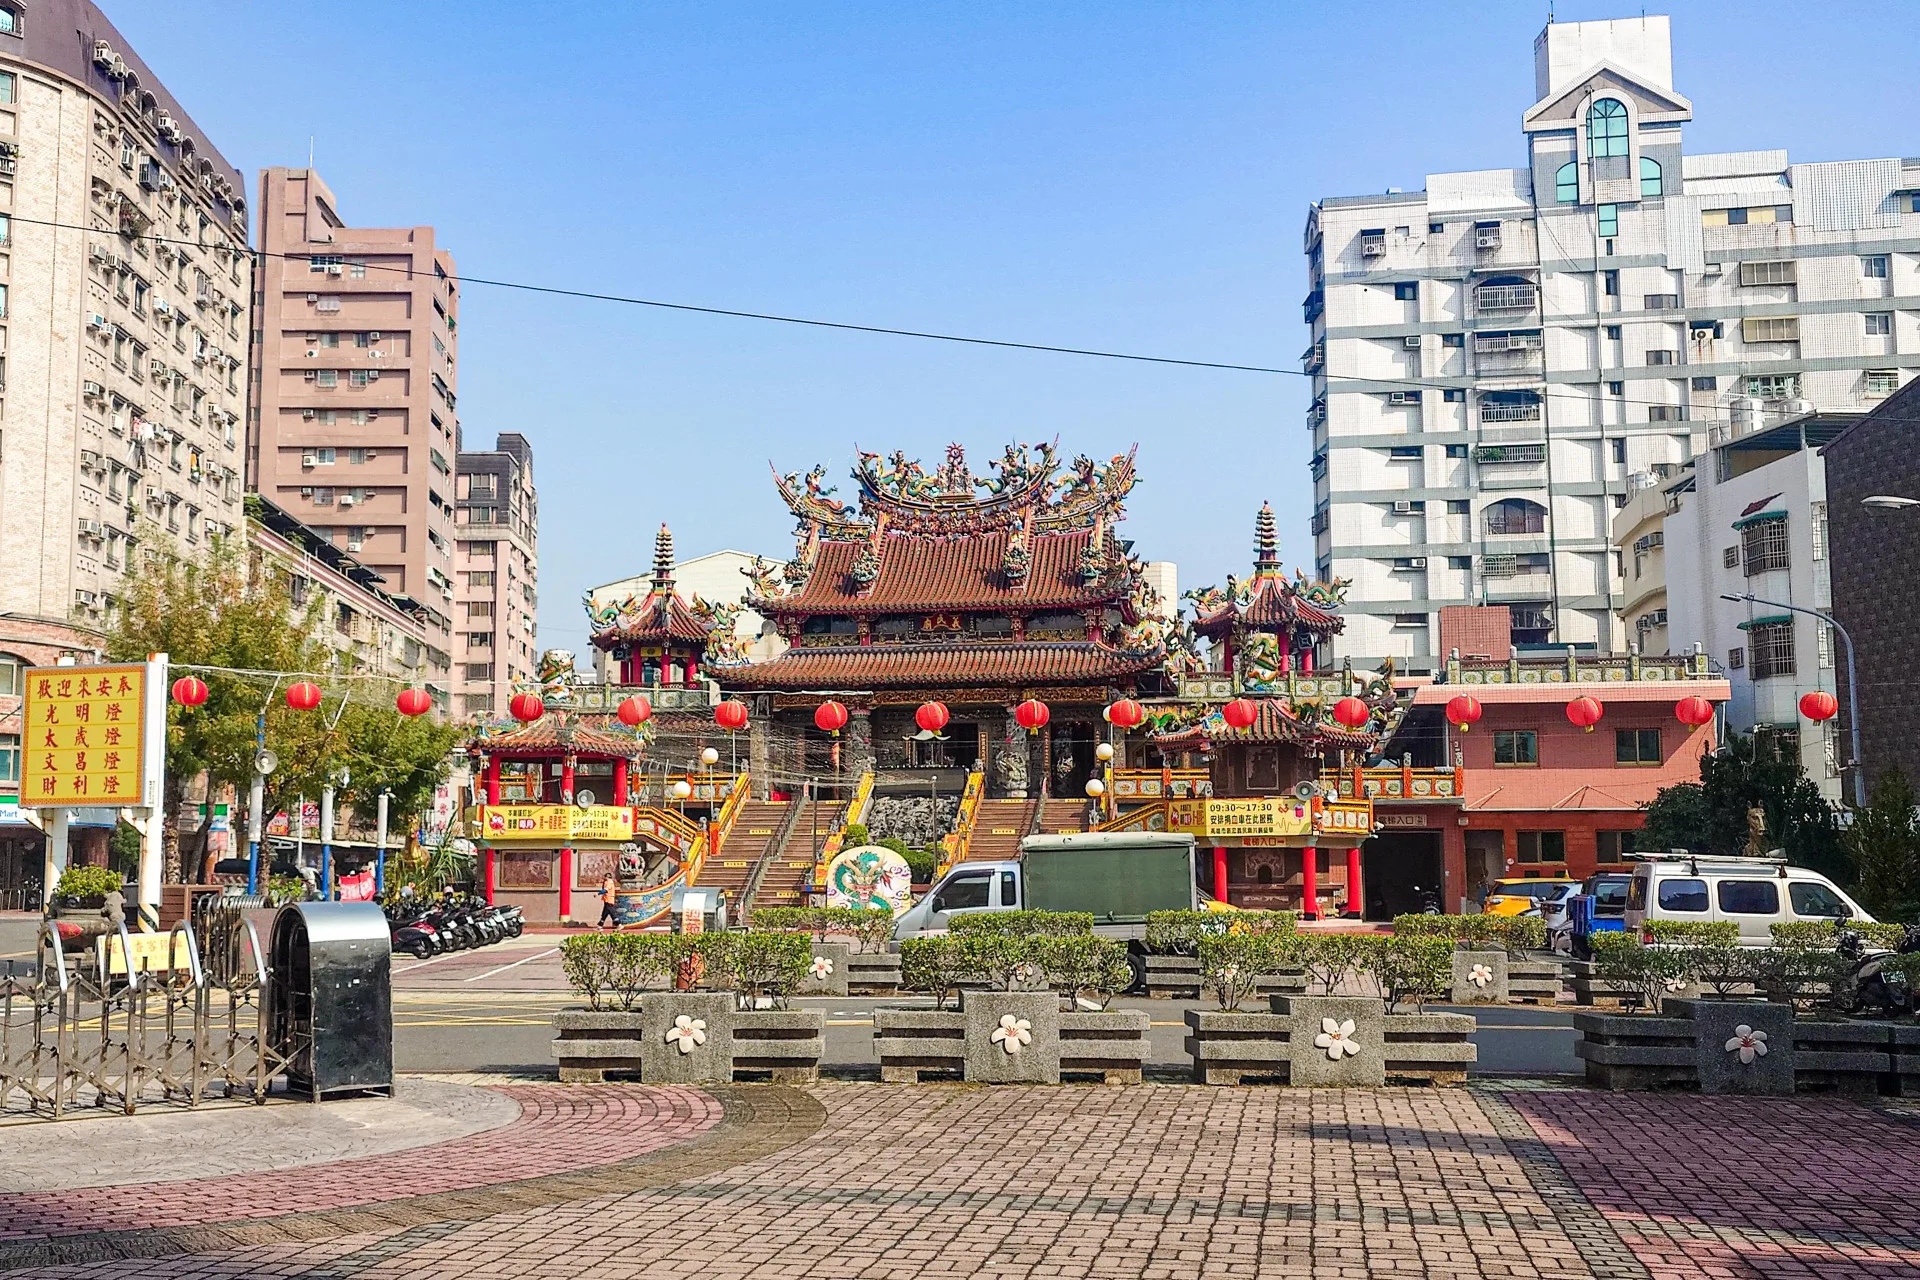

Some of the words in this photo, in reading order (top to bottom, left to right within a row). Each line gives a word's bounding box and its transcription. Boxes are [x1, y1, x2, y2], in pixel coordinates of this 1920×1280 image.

[37, 675, 132, 699] 歡迎來安奉
[45, 703, 122, 724] 光明燈
[44, 726, 121, 748] 太歲燈
[43, 751, 121, 771] 文昌燈
[42, 775, 120, 796] 財利燈
[1243, 837, 1277, 846] 電梯入口
